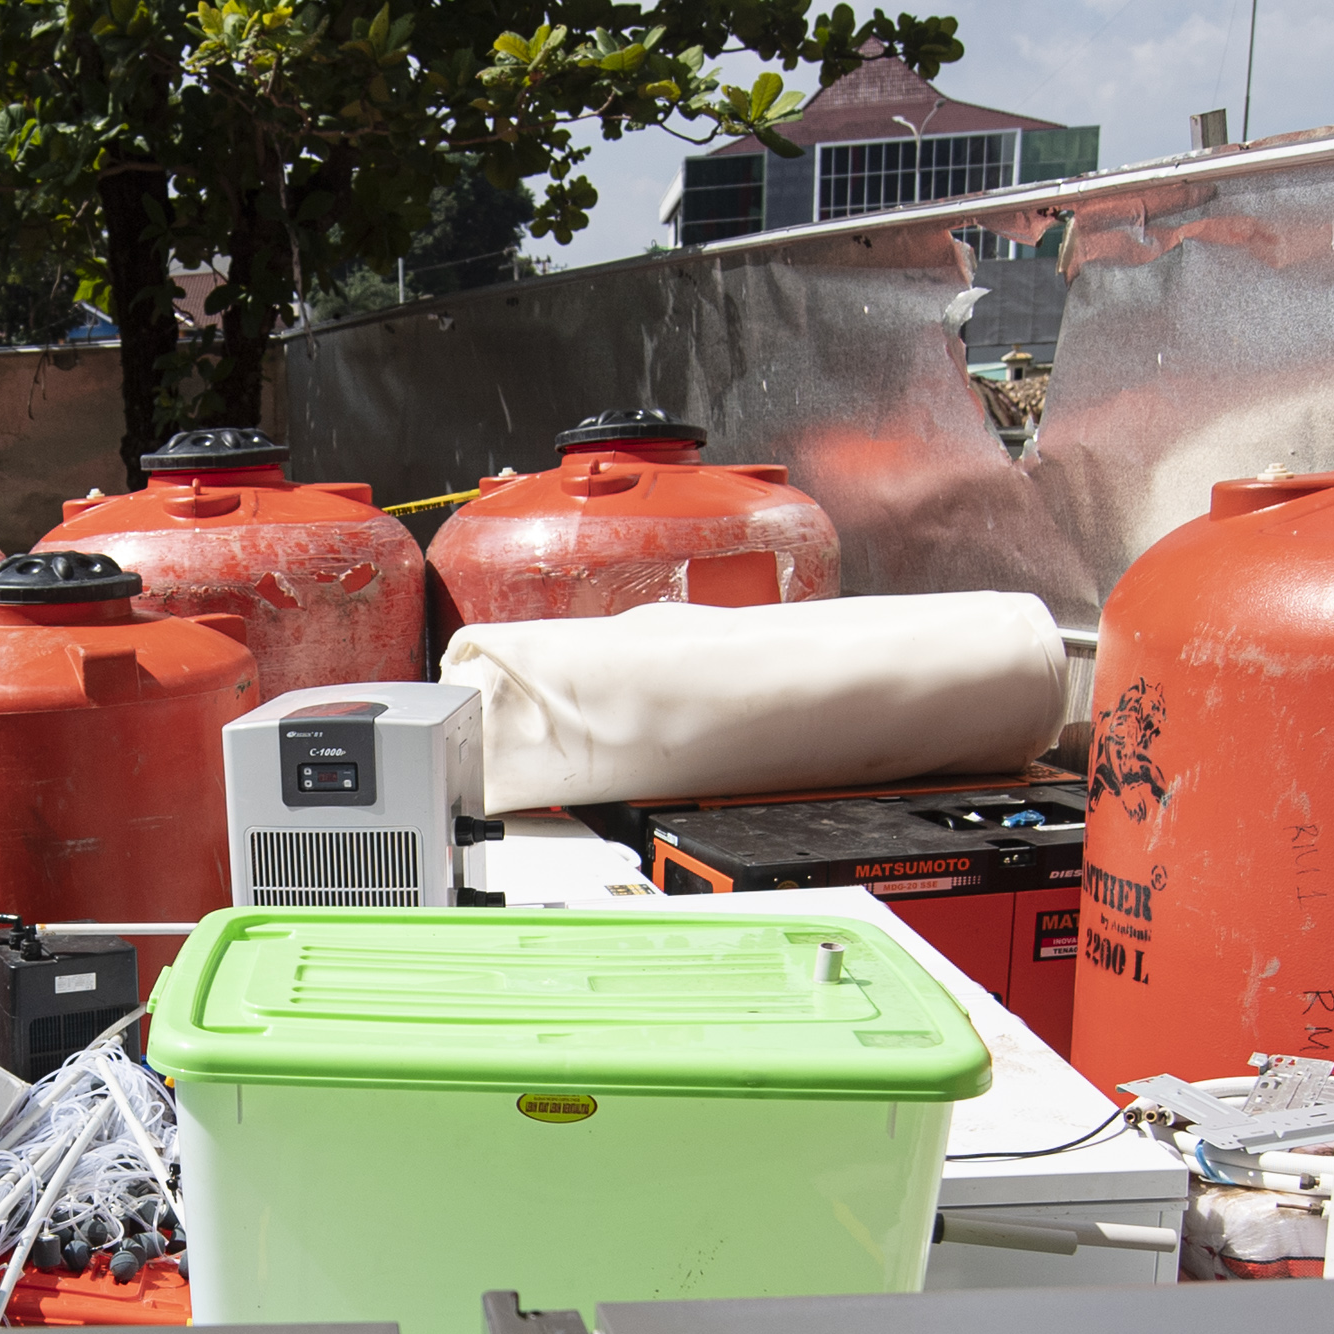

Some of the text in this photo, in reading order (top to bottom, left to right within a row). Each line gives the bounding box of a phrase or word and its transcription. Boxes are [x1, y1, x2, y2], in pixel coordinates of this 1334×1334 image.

[855, 857, 971, 878] MATSUMOTO
[1085, 928, 1126, 976] 2200
[1132, 949, 1149, 985] L
